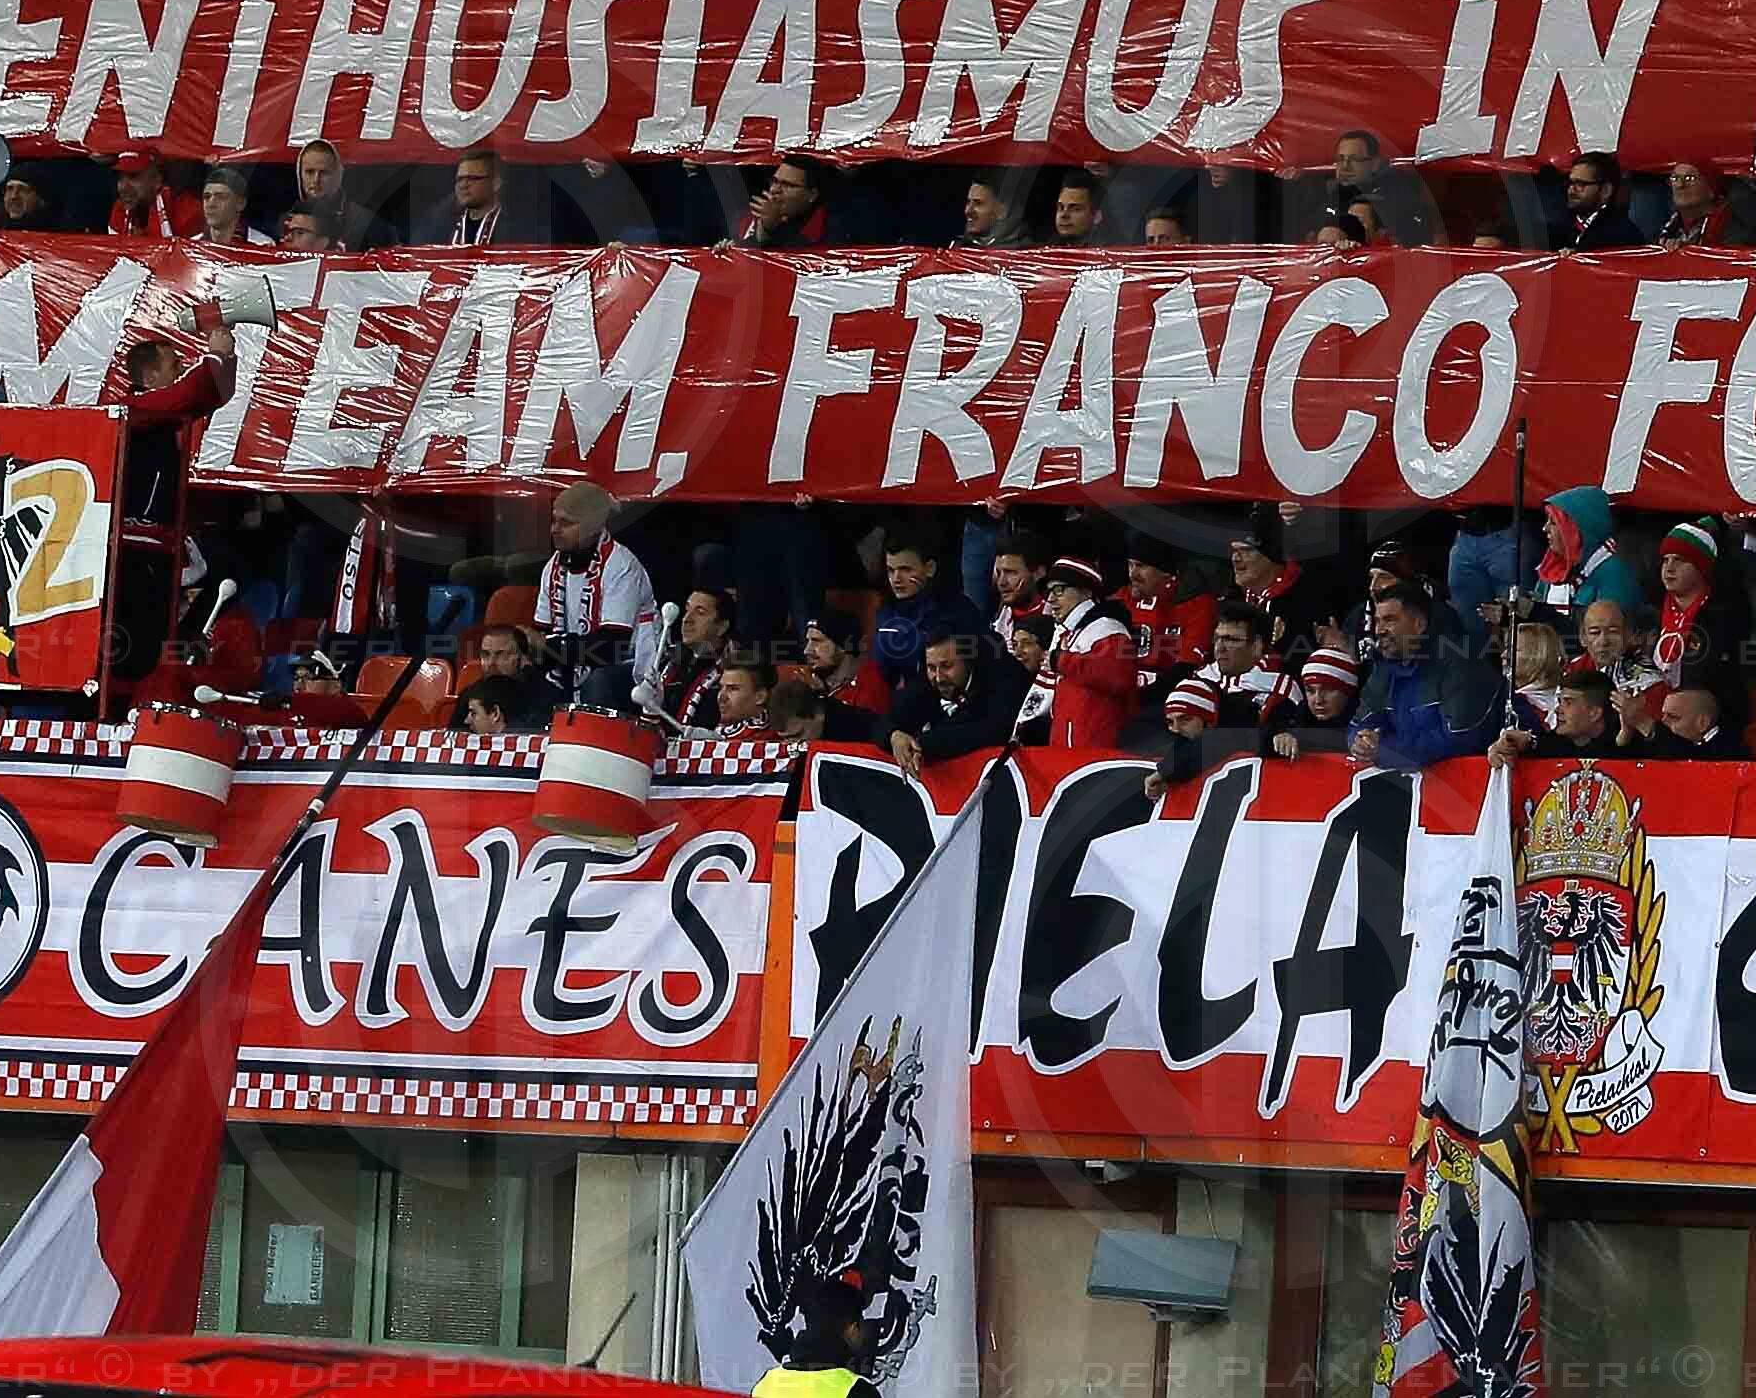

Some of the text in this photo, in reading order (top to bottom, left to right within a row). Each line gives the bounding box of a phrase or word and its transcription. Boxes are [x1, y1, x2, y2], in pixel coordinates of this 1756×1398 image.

[767, 266, 1519, 499] FRANCO
[1573, 1052, 1651, 1109] Pielachtal
[1611, 1100, 1642, 1132] 2017
